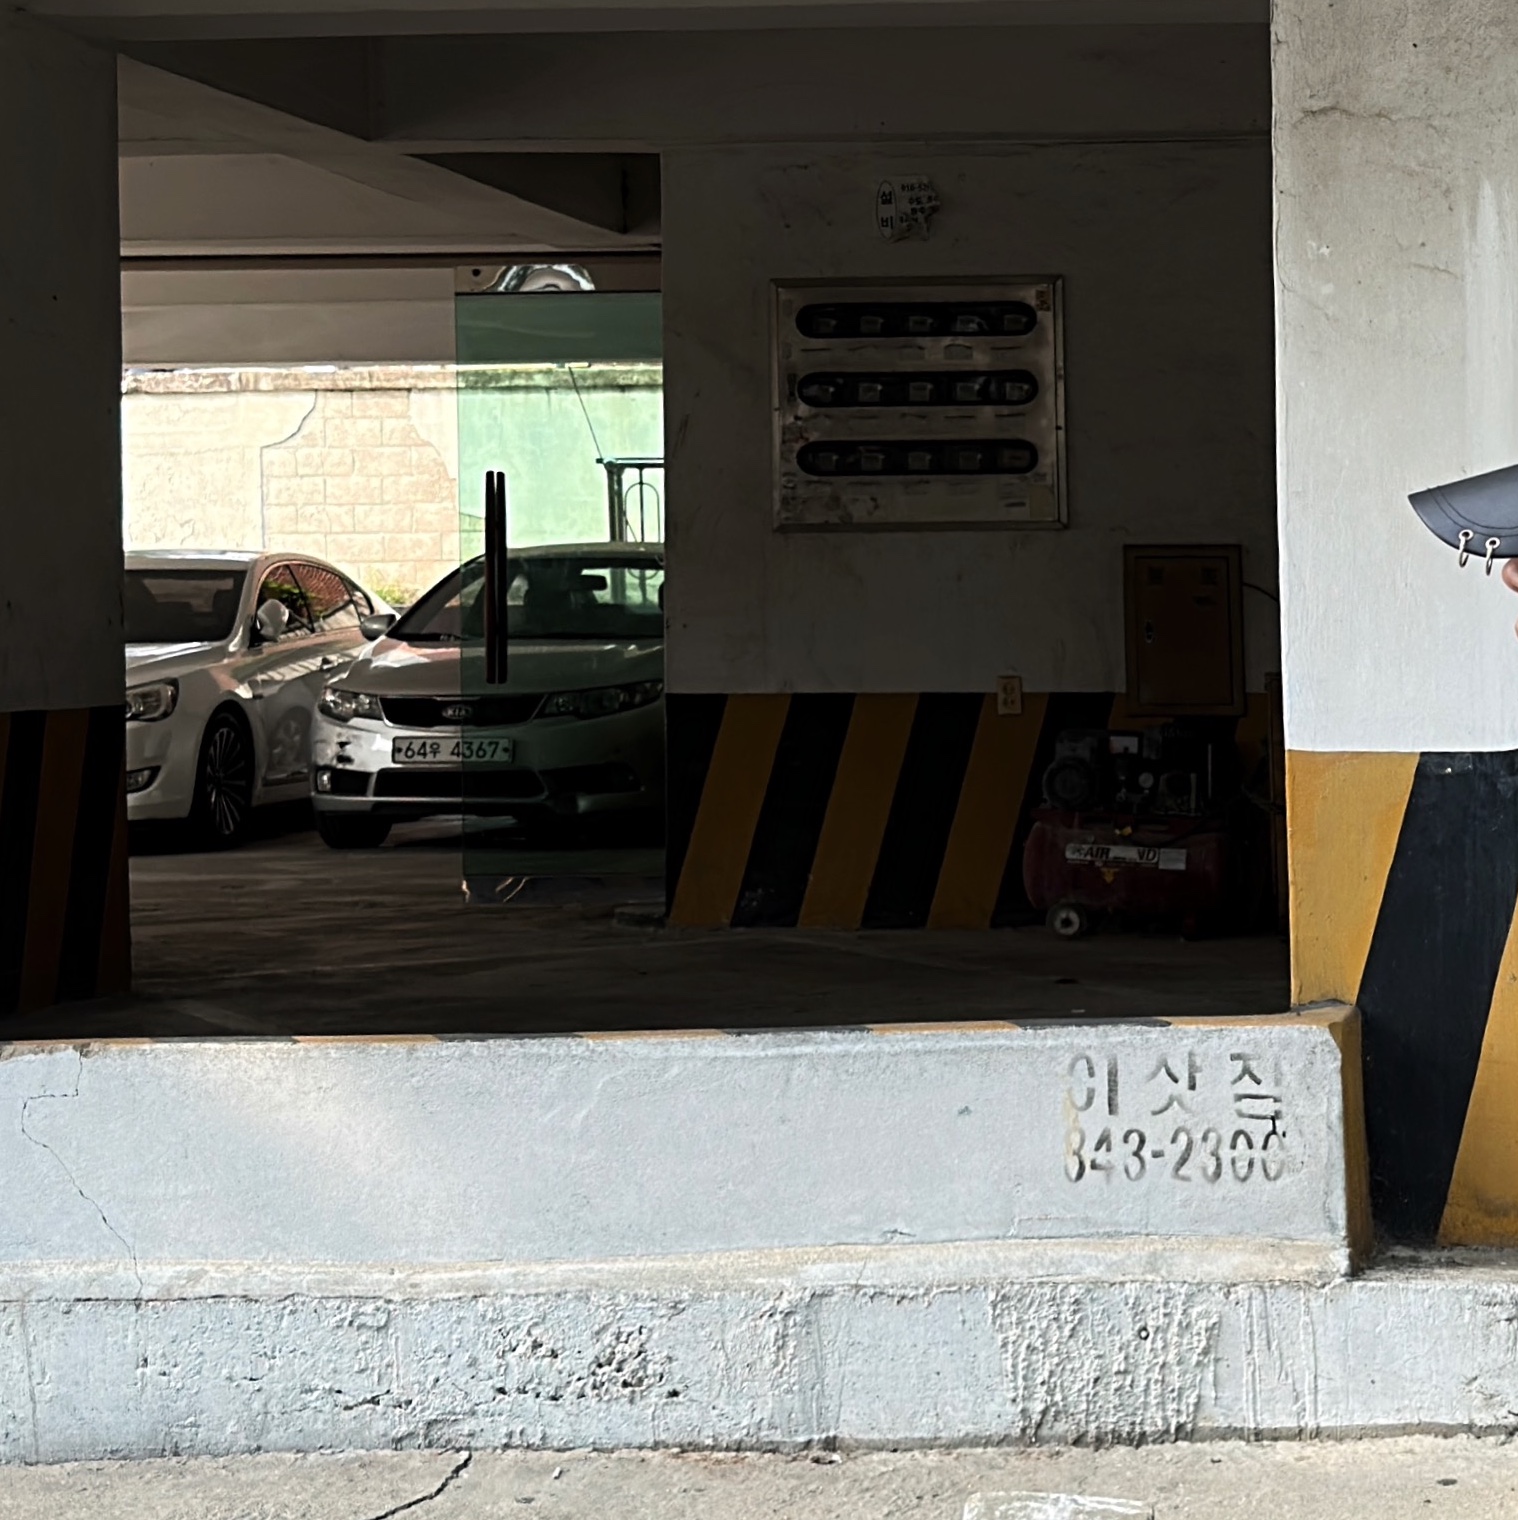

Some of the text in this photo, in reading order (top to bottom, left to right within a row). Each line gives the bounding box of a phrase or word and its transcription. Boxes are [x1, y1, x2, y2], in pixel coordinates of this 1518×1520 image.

[404, 741, 500, 759] 64우 4367
[1067, 1052, 1283, 1120] 이삿짐
